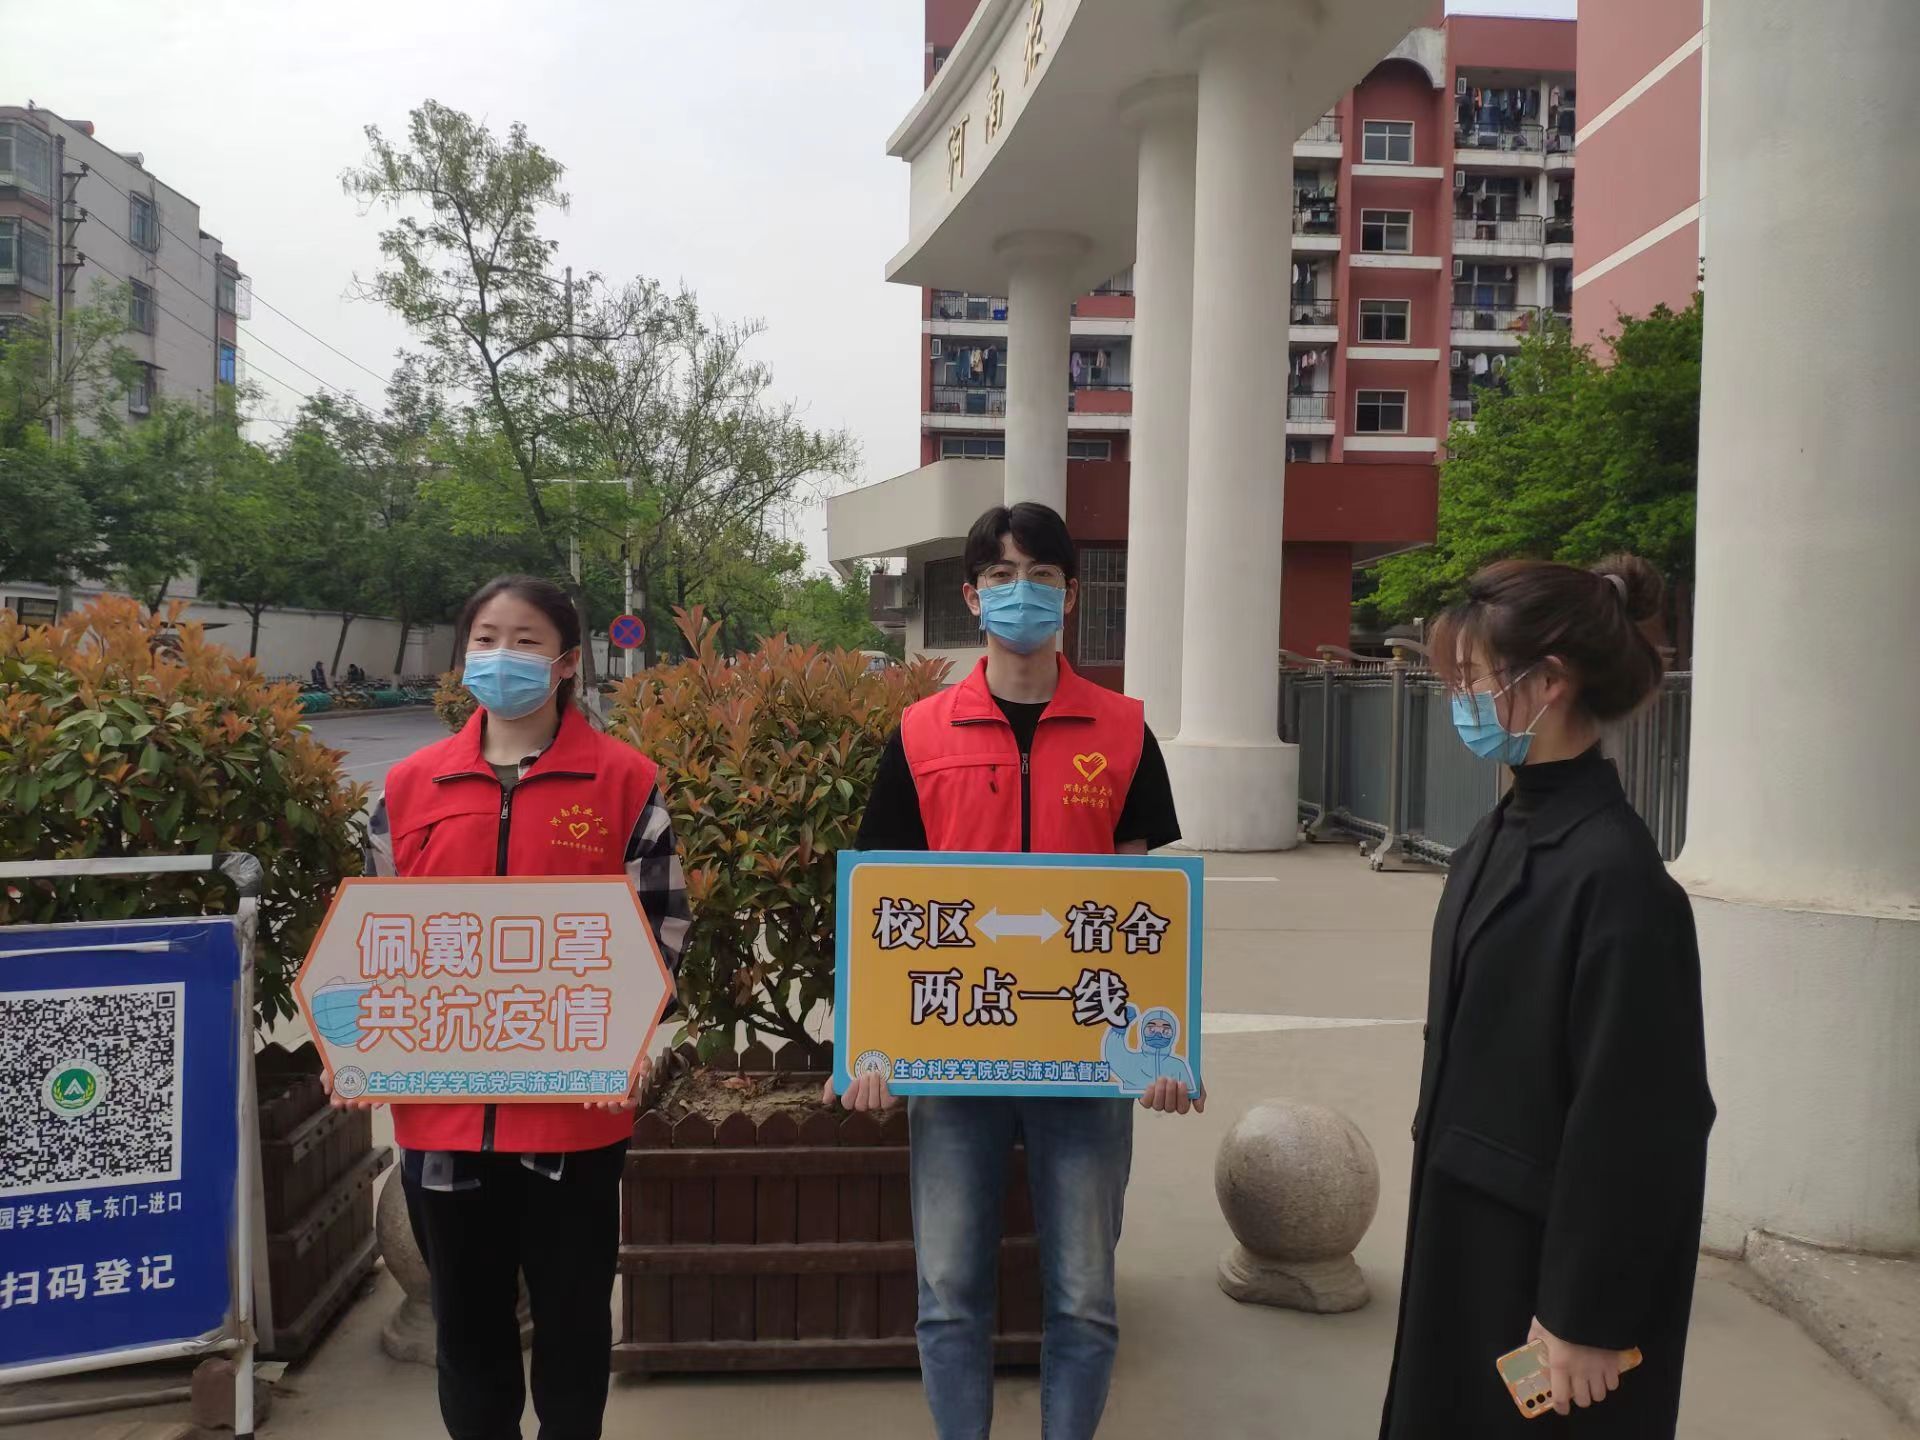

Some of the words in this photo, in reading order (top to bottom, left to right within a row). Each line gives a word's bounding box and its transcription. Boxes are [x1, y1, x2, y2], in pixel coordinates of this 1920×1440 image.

[356, 911, 611, 979] 佩戴口罩
[873, 897, 975, 950] 校区
[1065, 901, 1170, 953] 宿舍
[355, 984, 611, 1053] 共抗疫情
[908, 967, 1130, 1028] 两点一线
[367, 1069, 628, 1096] 生命科学学院党员流动监督岗
[893, 1058, 1111, 1082] 生命科学学院党员流动监督岗
[0, 1254, 176, 1310] 扫码登记
